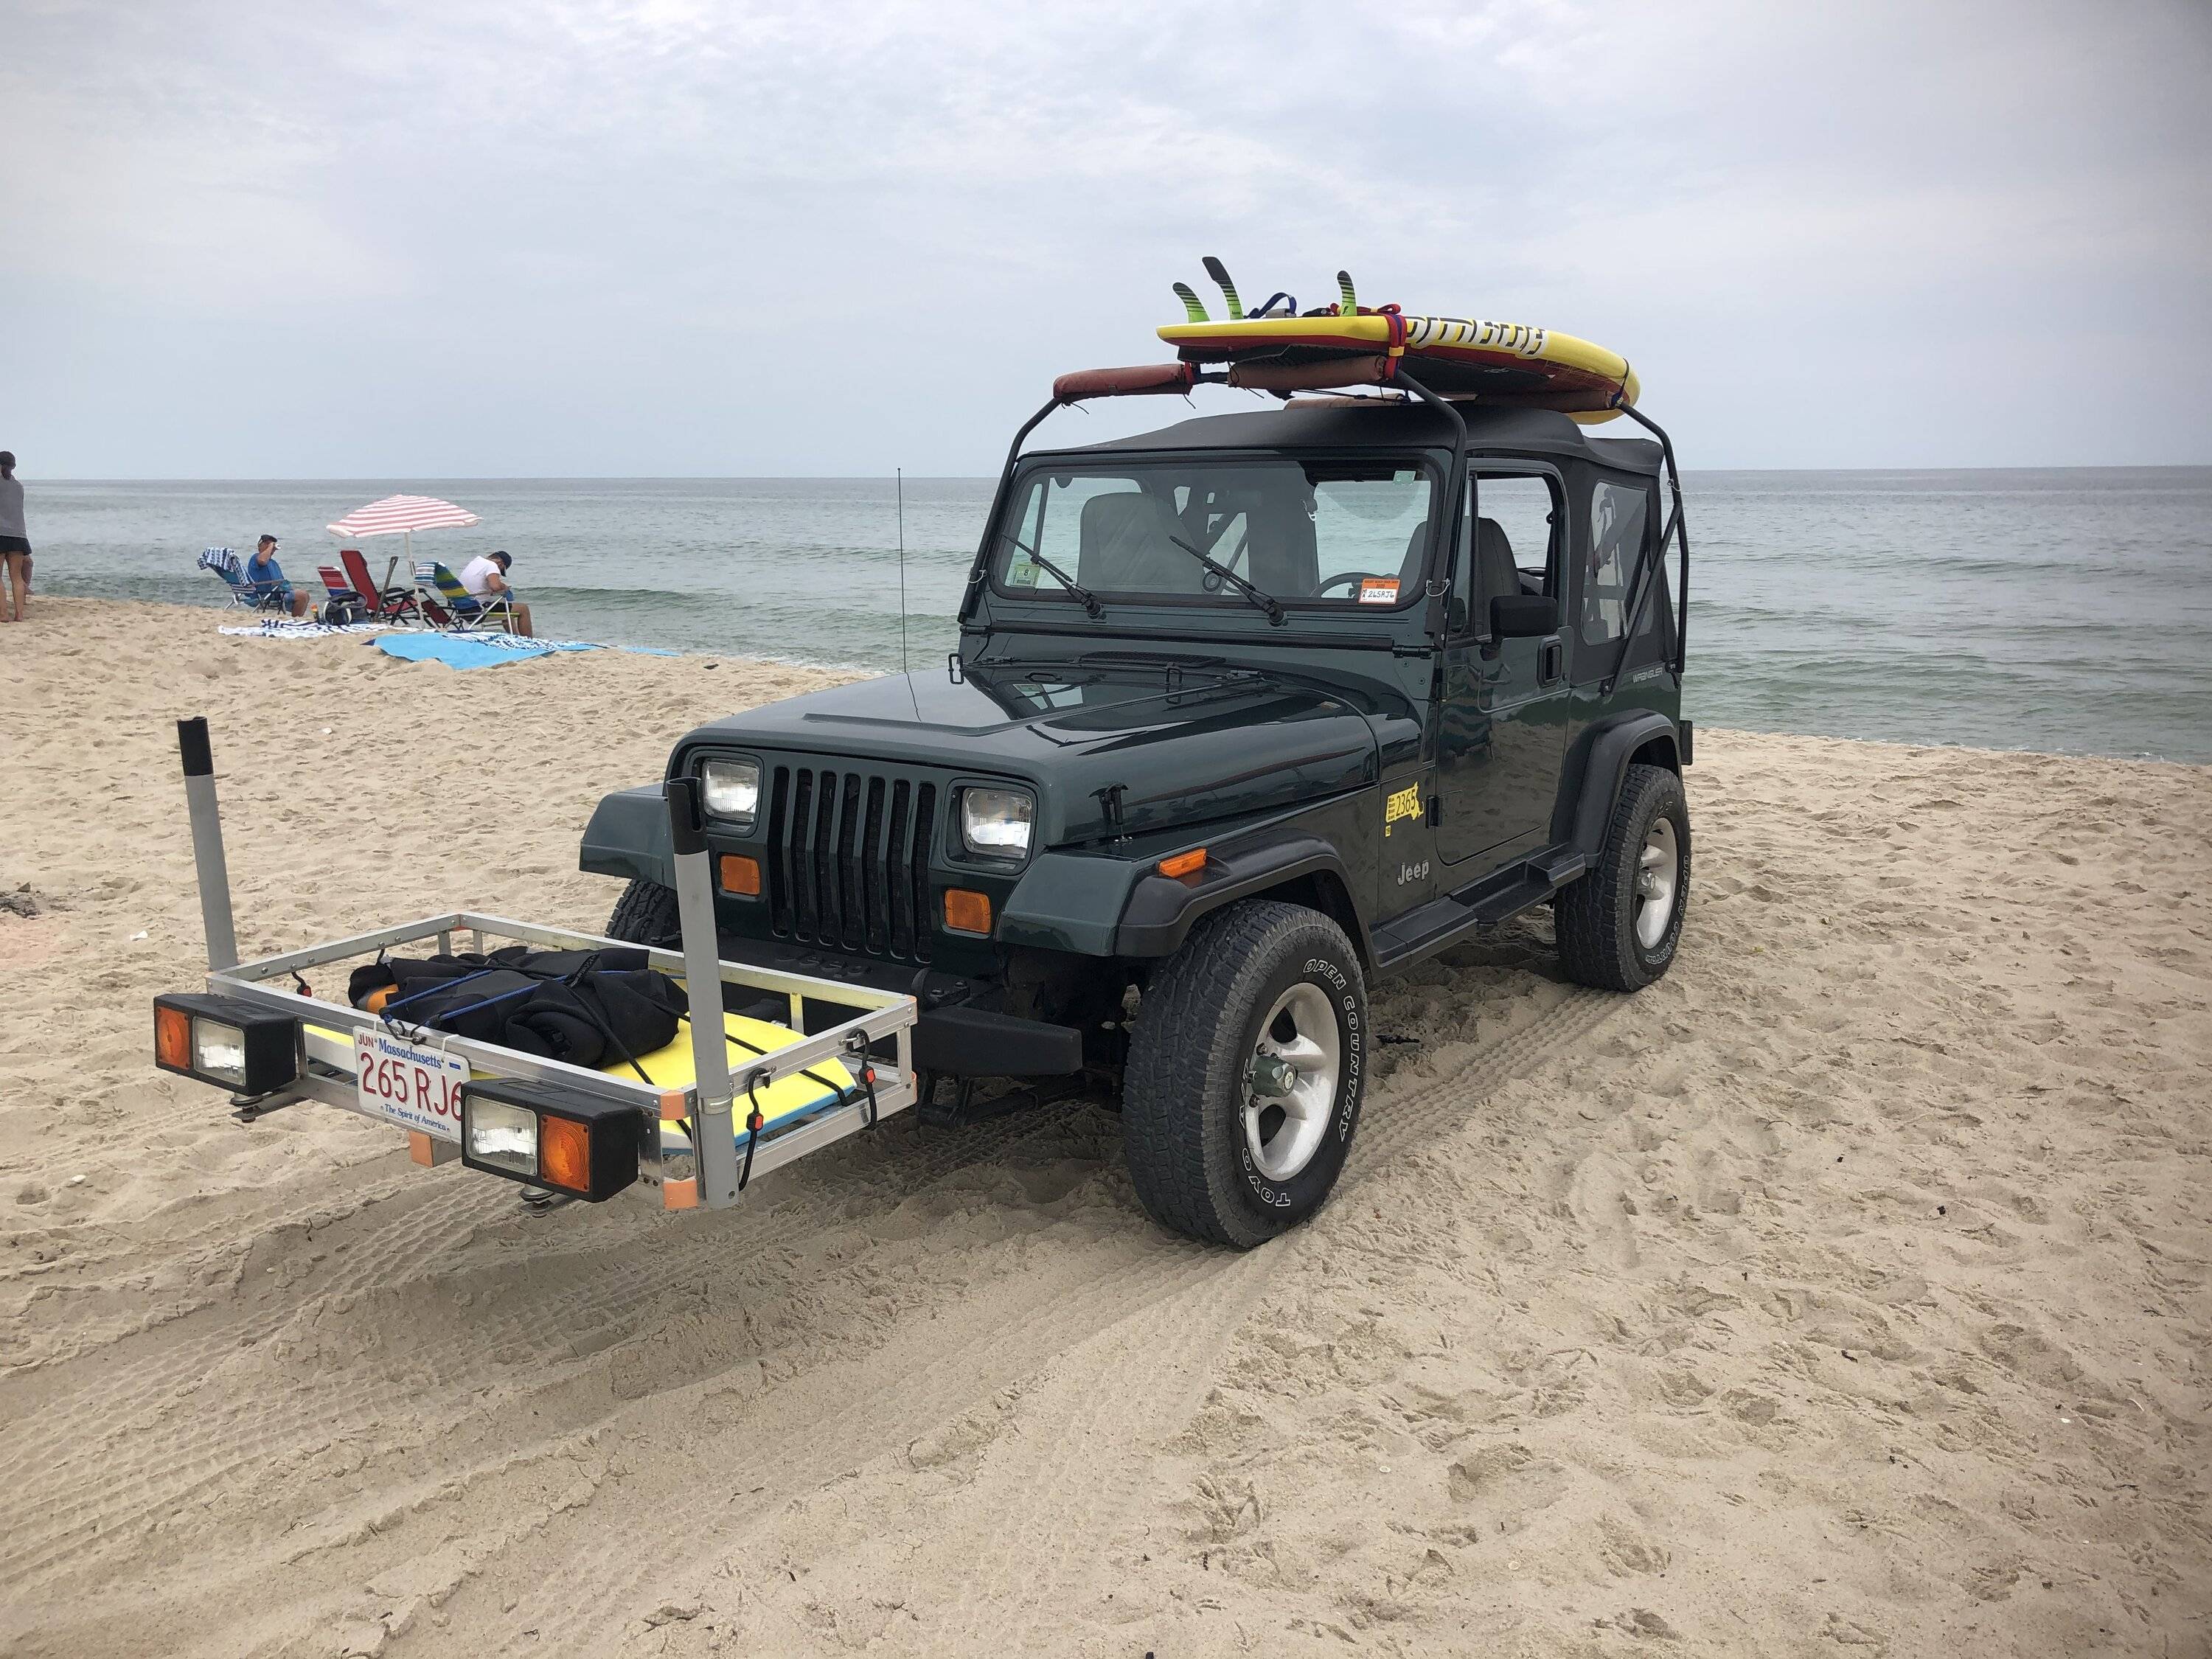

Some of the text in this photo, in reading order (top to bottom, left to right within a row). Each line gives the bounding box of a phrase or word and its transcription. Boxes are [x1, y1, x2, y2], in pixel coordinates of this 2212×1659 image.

[1396, 788, 1416, 817] 2365
[1397, 860, 1430, 886] Jeep
[358, 1033, 374, 1048] JUN
[379, 1037, 442, 1069] Massachusetts
[1303, 959, 1360, 1143] OPEN COUNTRY
[361, 1052, 462, 1121] 265 RJ6
[385, 1103, 447, 1131] The Spirit of America
[1242, 1147, 1291, 1207] TOYO
